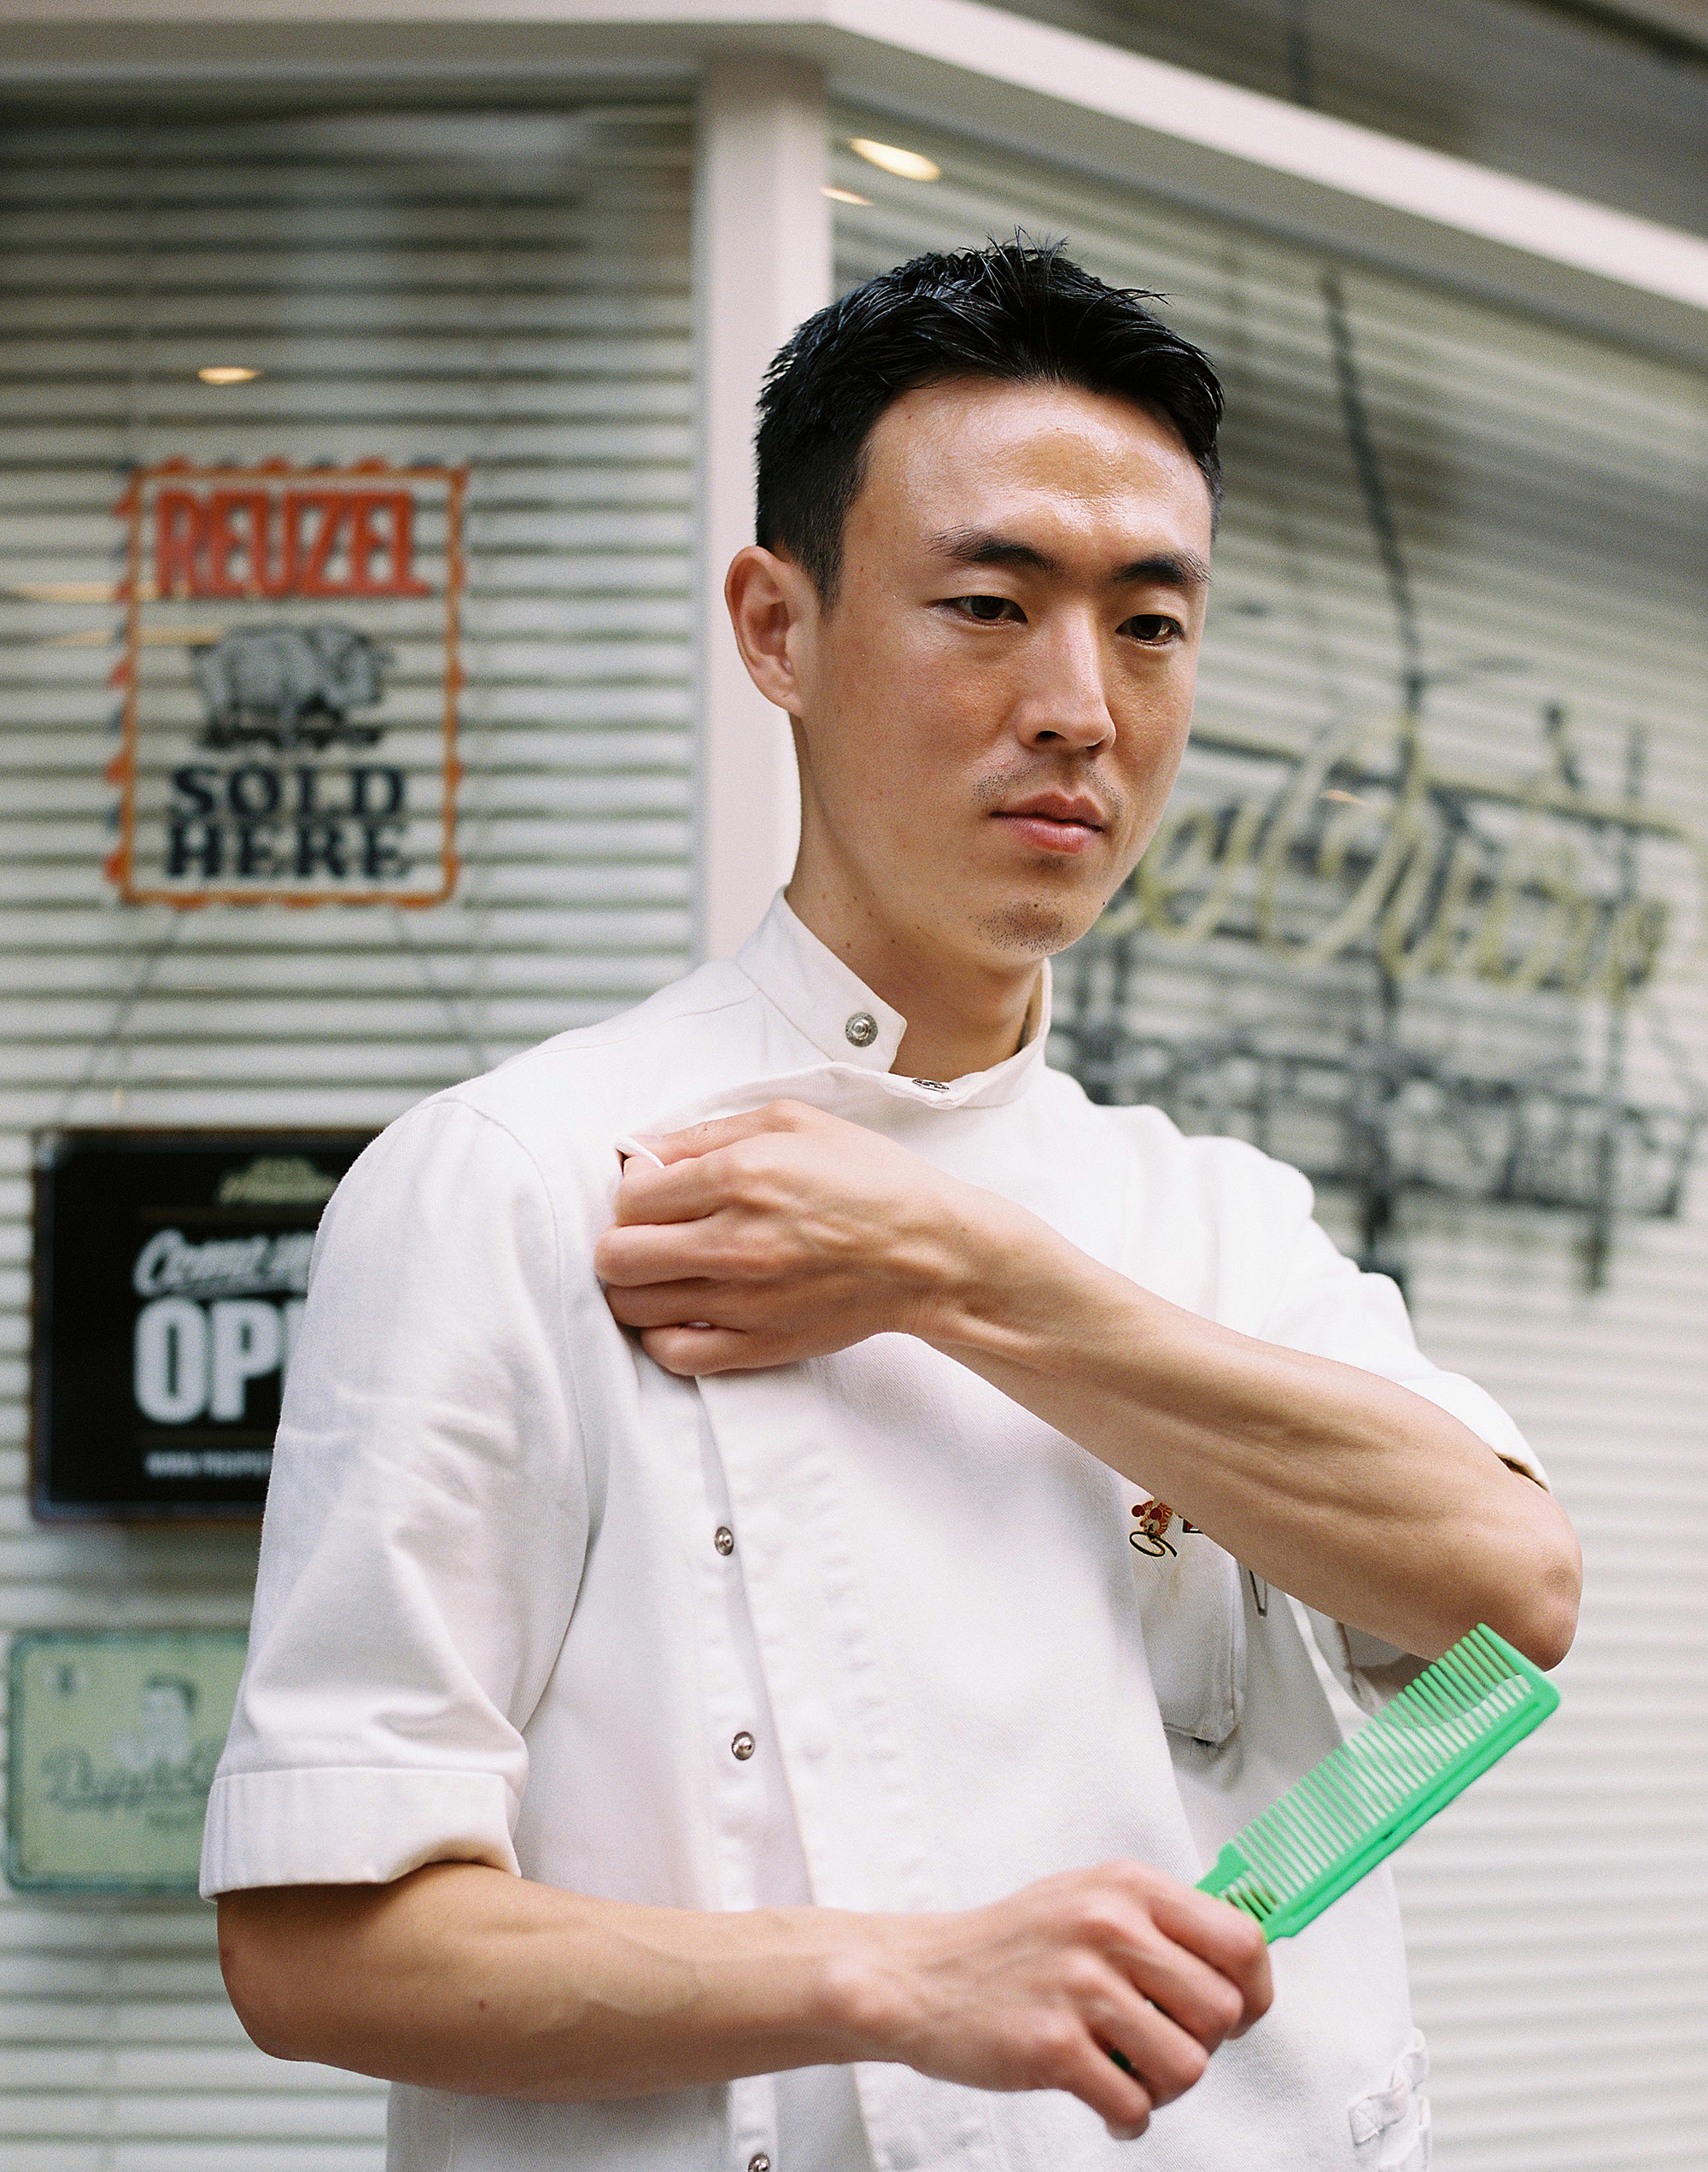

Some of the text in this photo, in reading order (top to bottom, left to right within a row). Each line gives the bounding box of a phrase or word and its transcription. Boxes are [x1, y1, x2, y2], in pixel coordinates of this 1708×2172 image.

[155, 489, 430, 598] REUZEL
[171, 764, 405, 818] SOLD
[166, 818, 413, 879] HERE
[133, 1297, 306, 1425] OP
